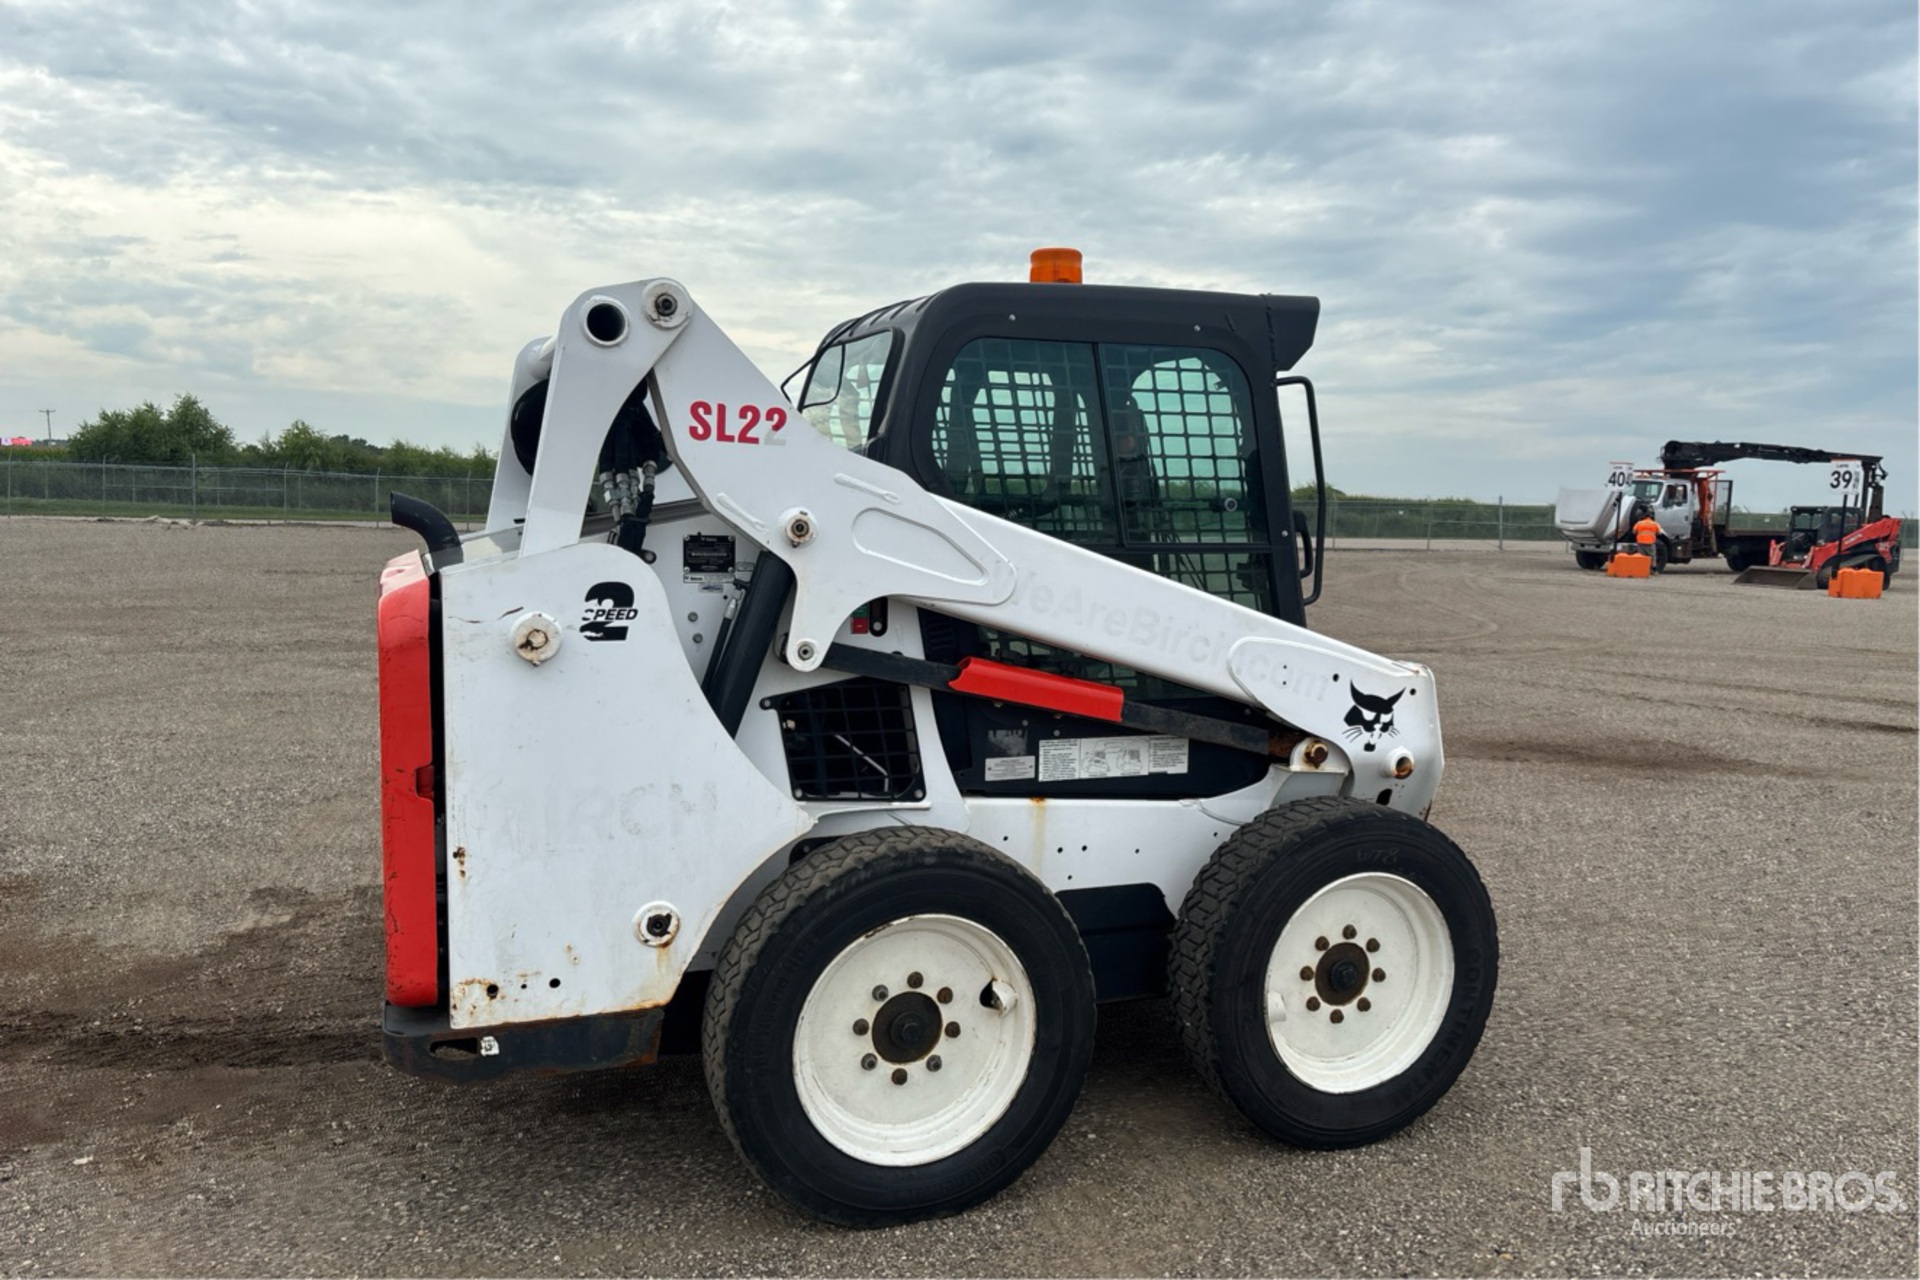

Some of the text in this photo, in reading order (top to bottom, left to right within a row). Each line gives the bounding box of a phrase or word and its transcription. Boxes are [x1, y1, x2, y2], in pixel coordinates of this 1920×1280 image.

[1608, 471, 1626, 487] 40
[1830, 470, 1852, 489] 39
[581, 608, 638, 621] SPEED
